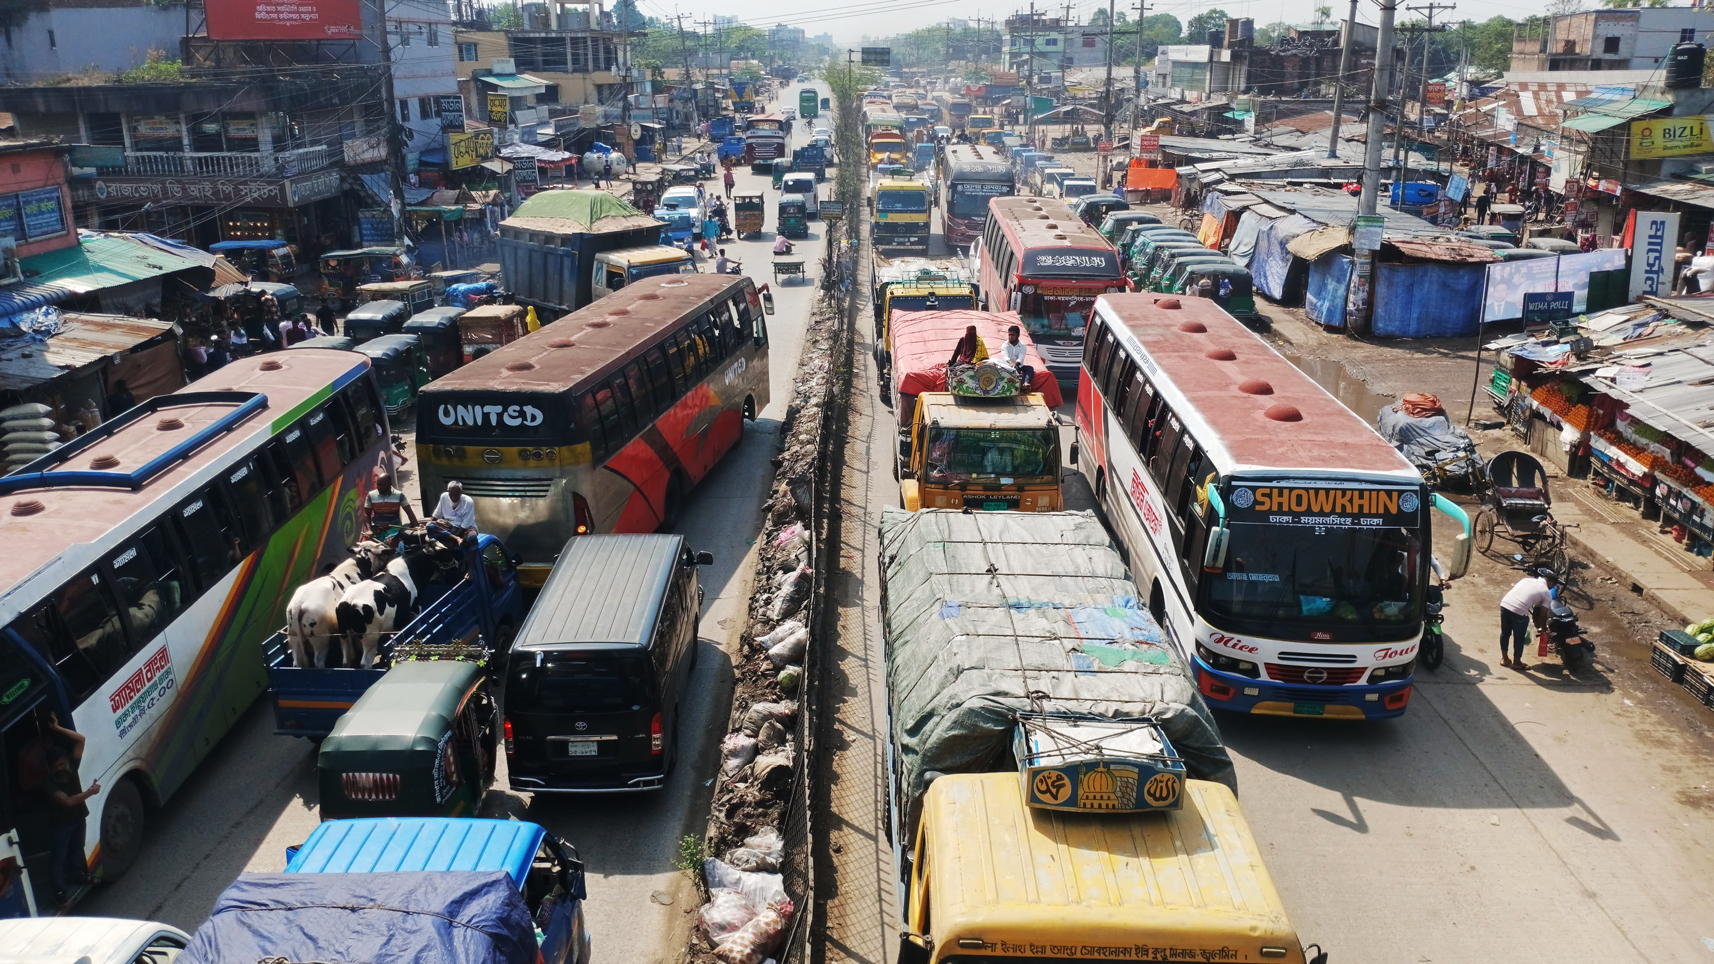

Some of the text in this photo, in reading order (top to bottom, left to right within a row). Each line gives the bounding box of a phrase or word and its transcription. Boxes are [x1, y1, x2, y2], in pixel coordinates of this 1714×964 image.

[106, 183, 162, 198] রাজভোগ
[167, 180, 183, 198] ভি
[186, 180, 215, 200] আই
[217, 180, 234, 199] পি
[438, 404, 544, 427] UNITED
[1255, 488, 1399, 515] SHOWKHIN
[1269, 515, 1292, 524] ঢাকা
[1300, 514, 1352, 526] ময়মনসিংহ
[1360, 517, 1383, 526] ঢাকা
[1209, 632, 1416, 662] Nice Tour
[109, 644, 170, 714] শ্যামলী বাংলা
[5, 680, 28, 702] WELCOME
